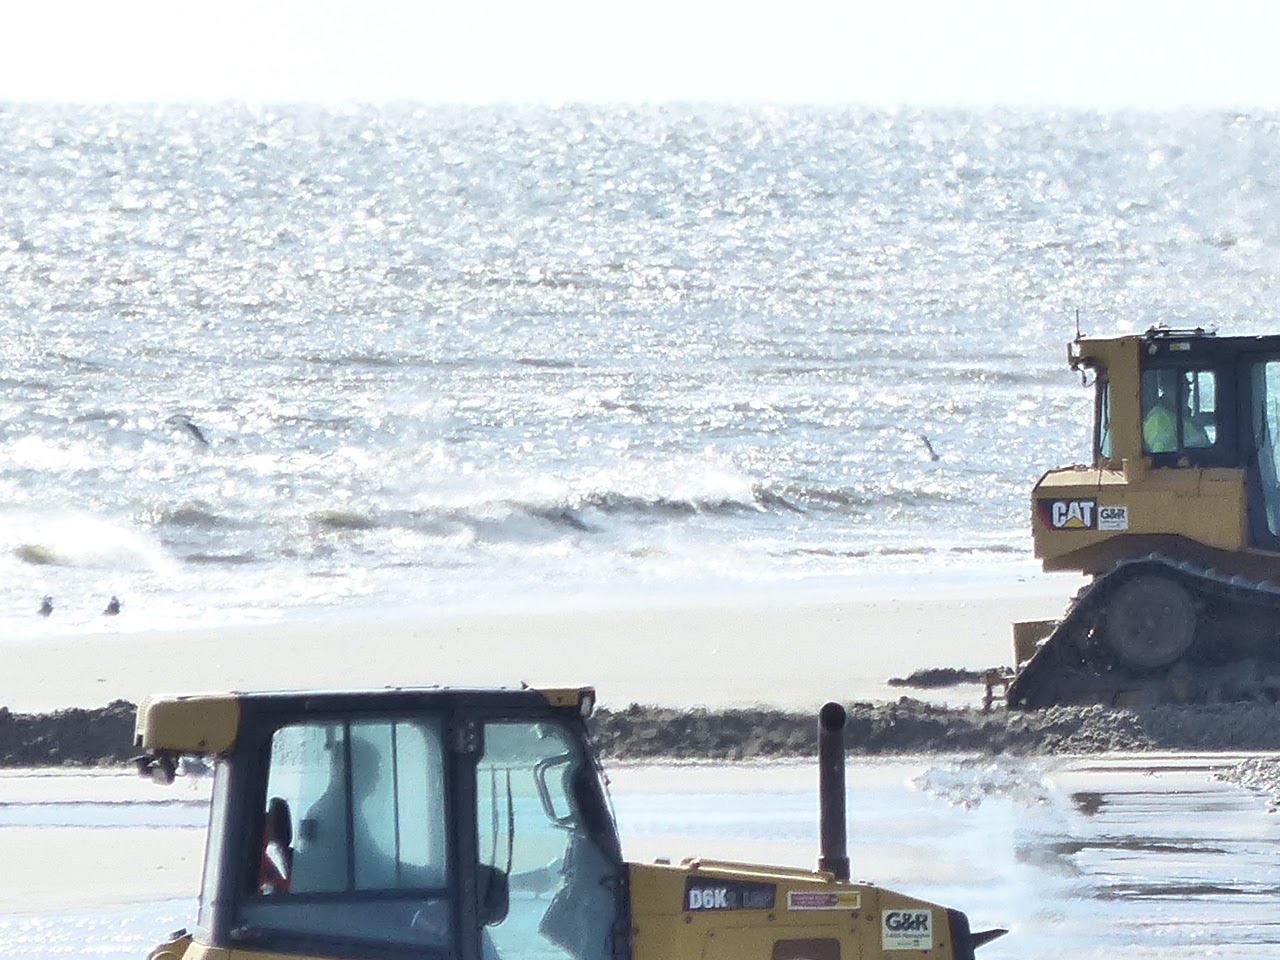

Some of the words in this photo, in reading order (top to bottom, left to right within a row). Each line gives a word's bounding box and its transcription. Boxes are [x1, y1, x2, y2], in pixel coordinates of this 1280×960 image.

[1052, 502, 1094, 528] CAT
[1100, 508, 1125, 520] G&R
[885, 912, 928, 932] G&R
